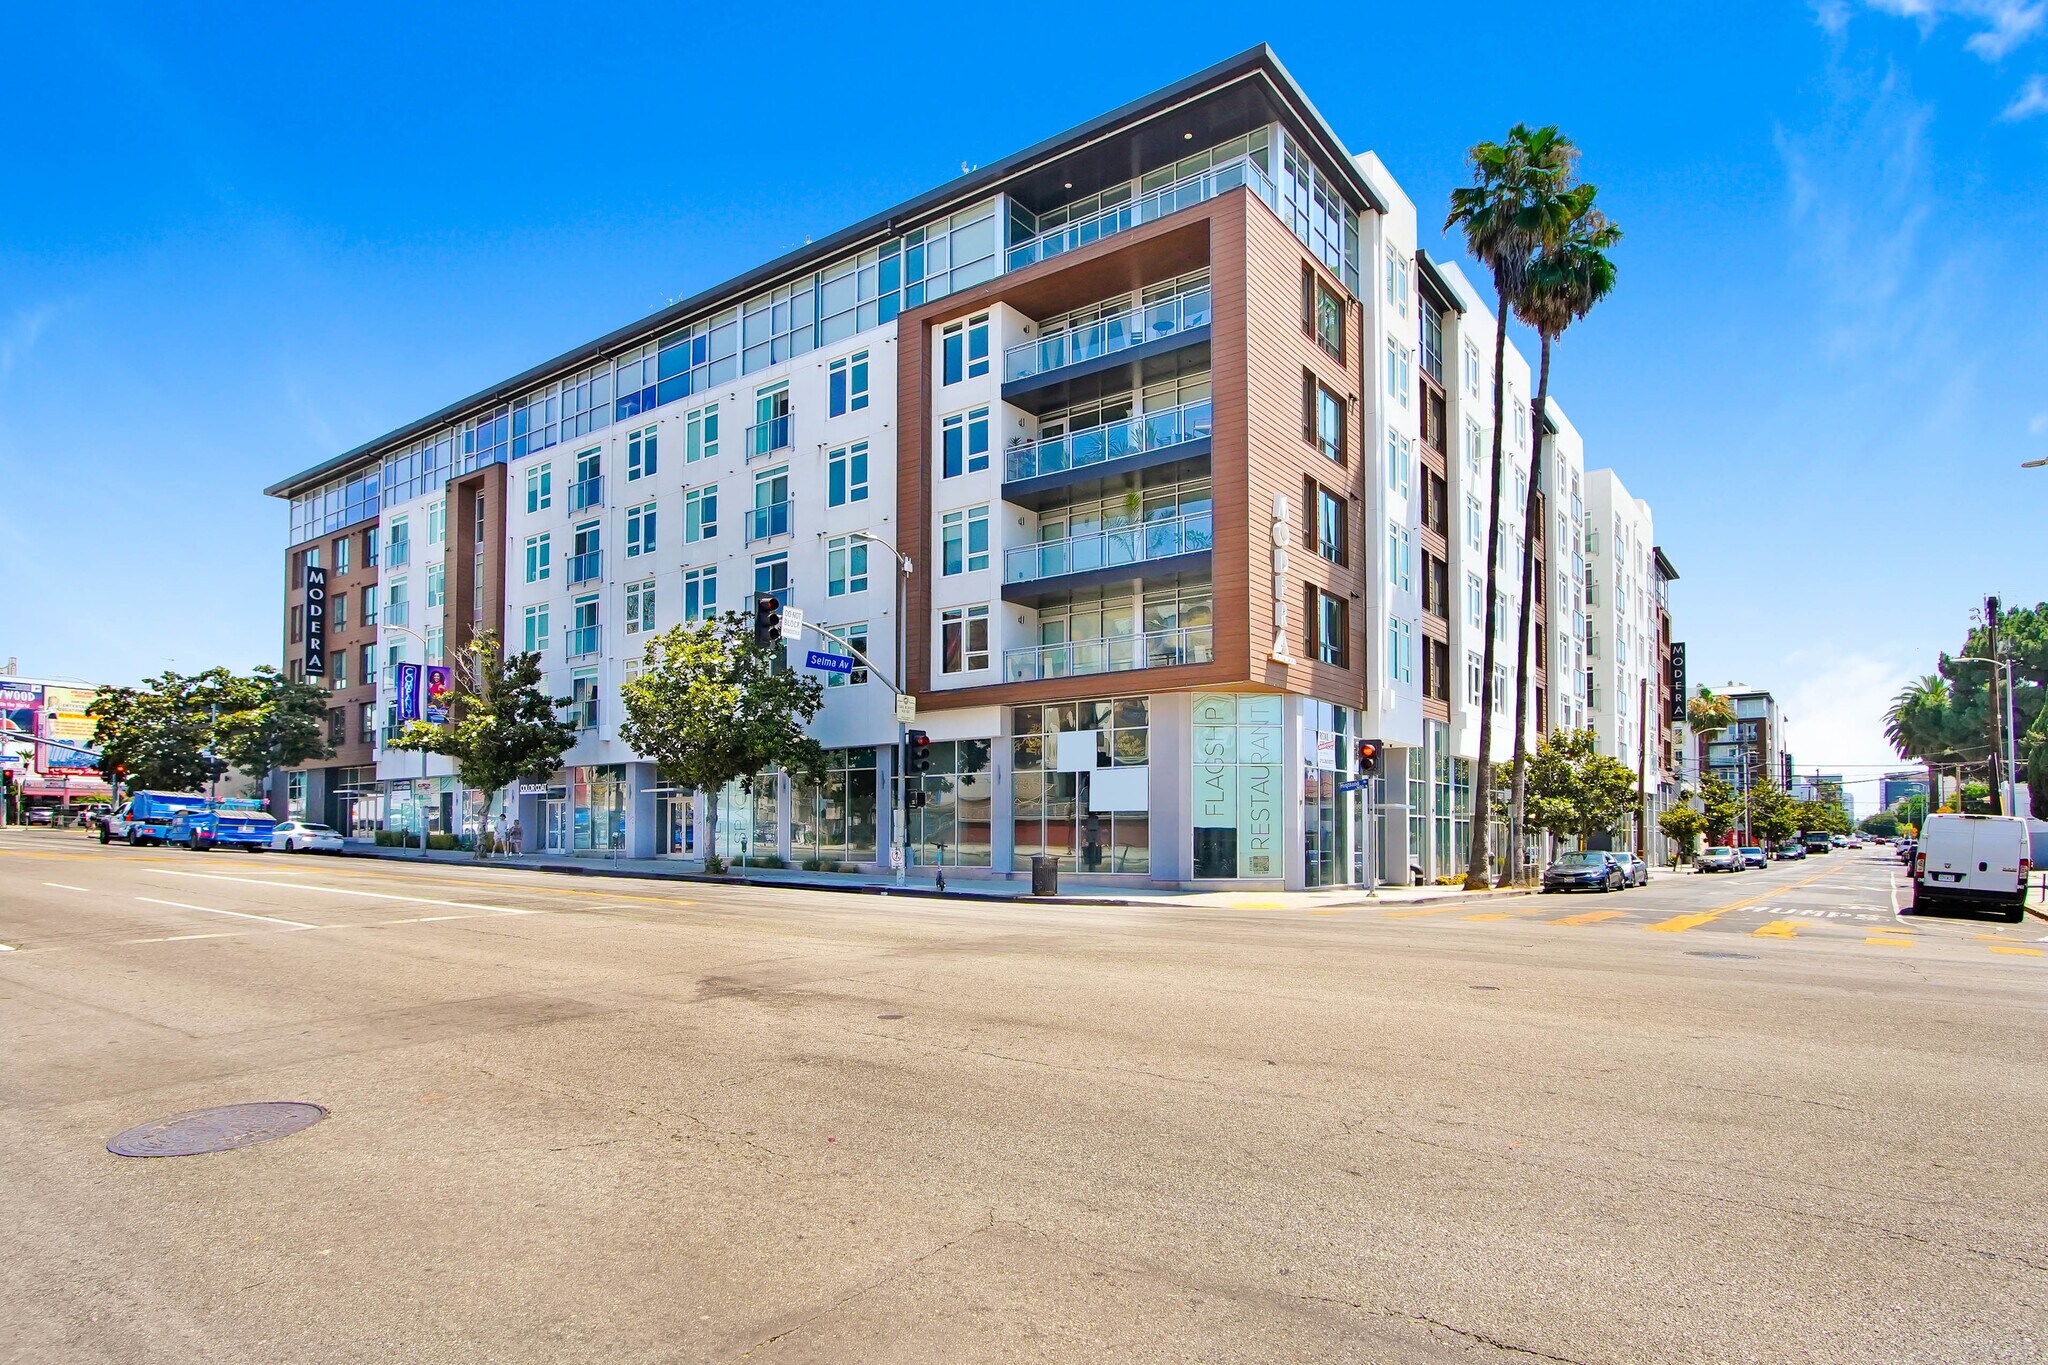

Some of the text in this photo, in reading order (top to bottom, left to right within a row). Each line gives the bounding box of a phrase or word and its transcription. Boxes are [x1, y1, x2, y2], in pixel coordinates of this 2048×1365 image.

[1272, 492, 1290, 656] MODERA
[309, 571, 324, 667] MODERA
[405, 667, 414, 718] COMPANY
[811, 655, 850, 669] Selma Av
[1672, 645, 1684, 714] MODERA
[520, 783, 547, 792] COLOR COAT
[1205, 707, 1225, 816] FLAGSHP
[1250, 705, 1270, 850] RESTAURANT
